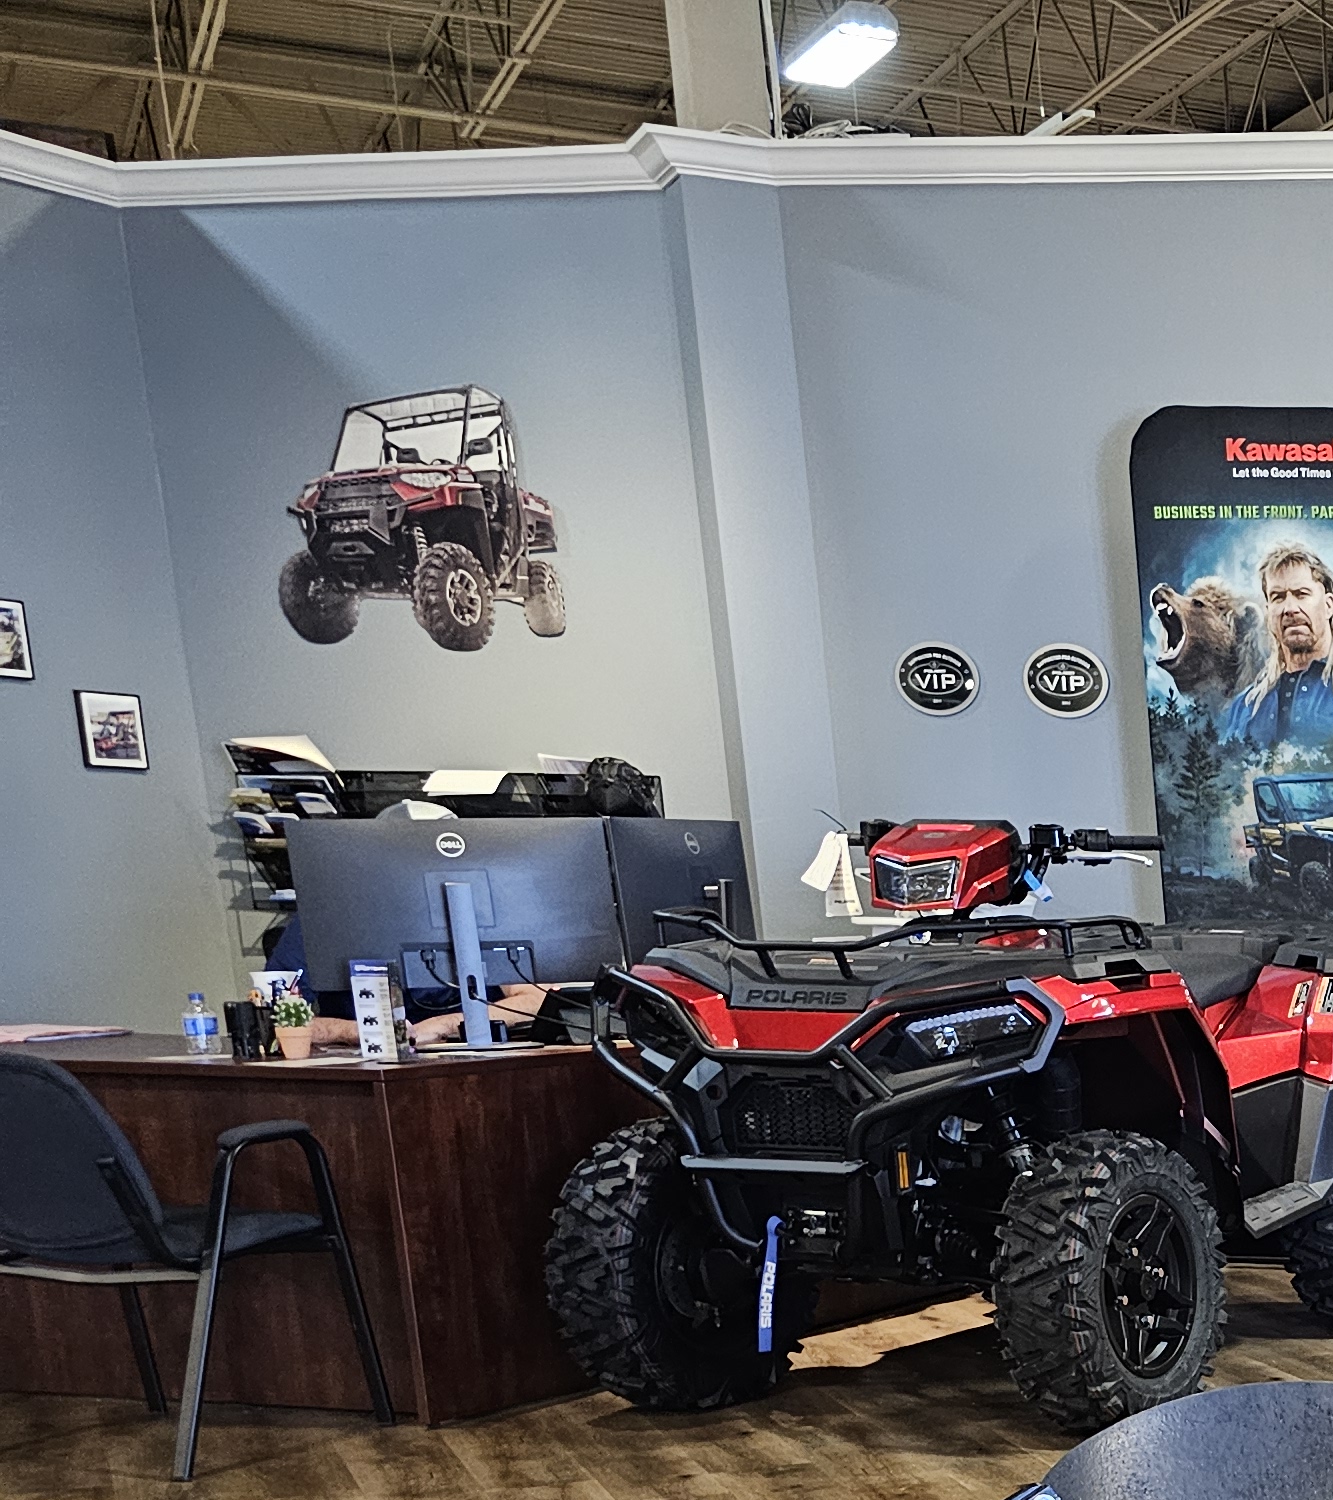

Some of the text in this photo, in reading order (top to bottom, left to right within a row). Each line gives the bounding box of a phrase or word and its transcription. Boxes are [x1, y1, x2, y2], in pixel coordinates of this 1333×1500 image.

[1232, 467, 1249, 478] Let
[1251, 467, 1269, 478] the
[1270, 467, 1298, 478] Good
[1299, 467, 1331, 478] Times
[1153, 505, 1216, 519] BUSINESS
[1219, 505, 1232, 518] IN
[1235, 505, 1259, 518] THE
[1263, 505, 1308, 519] FRONT.
[914, 673, 956, 690] VIP
[1043, 674, 1085, 692] VIP
[745, 989, 848, 1005] POLARIS
[760, 1261, 777, 1329] POLARIS
